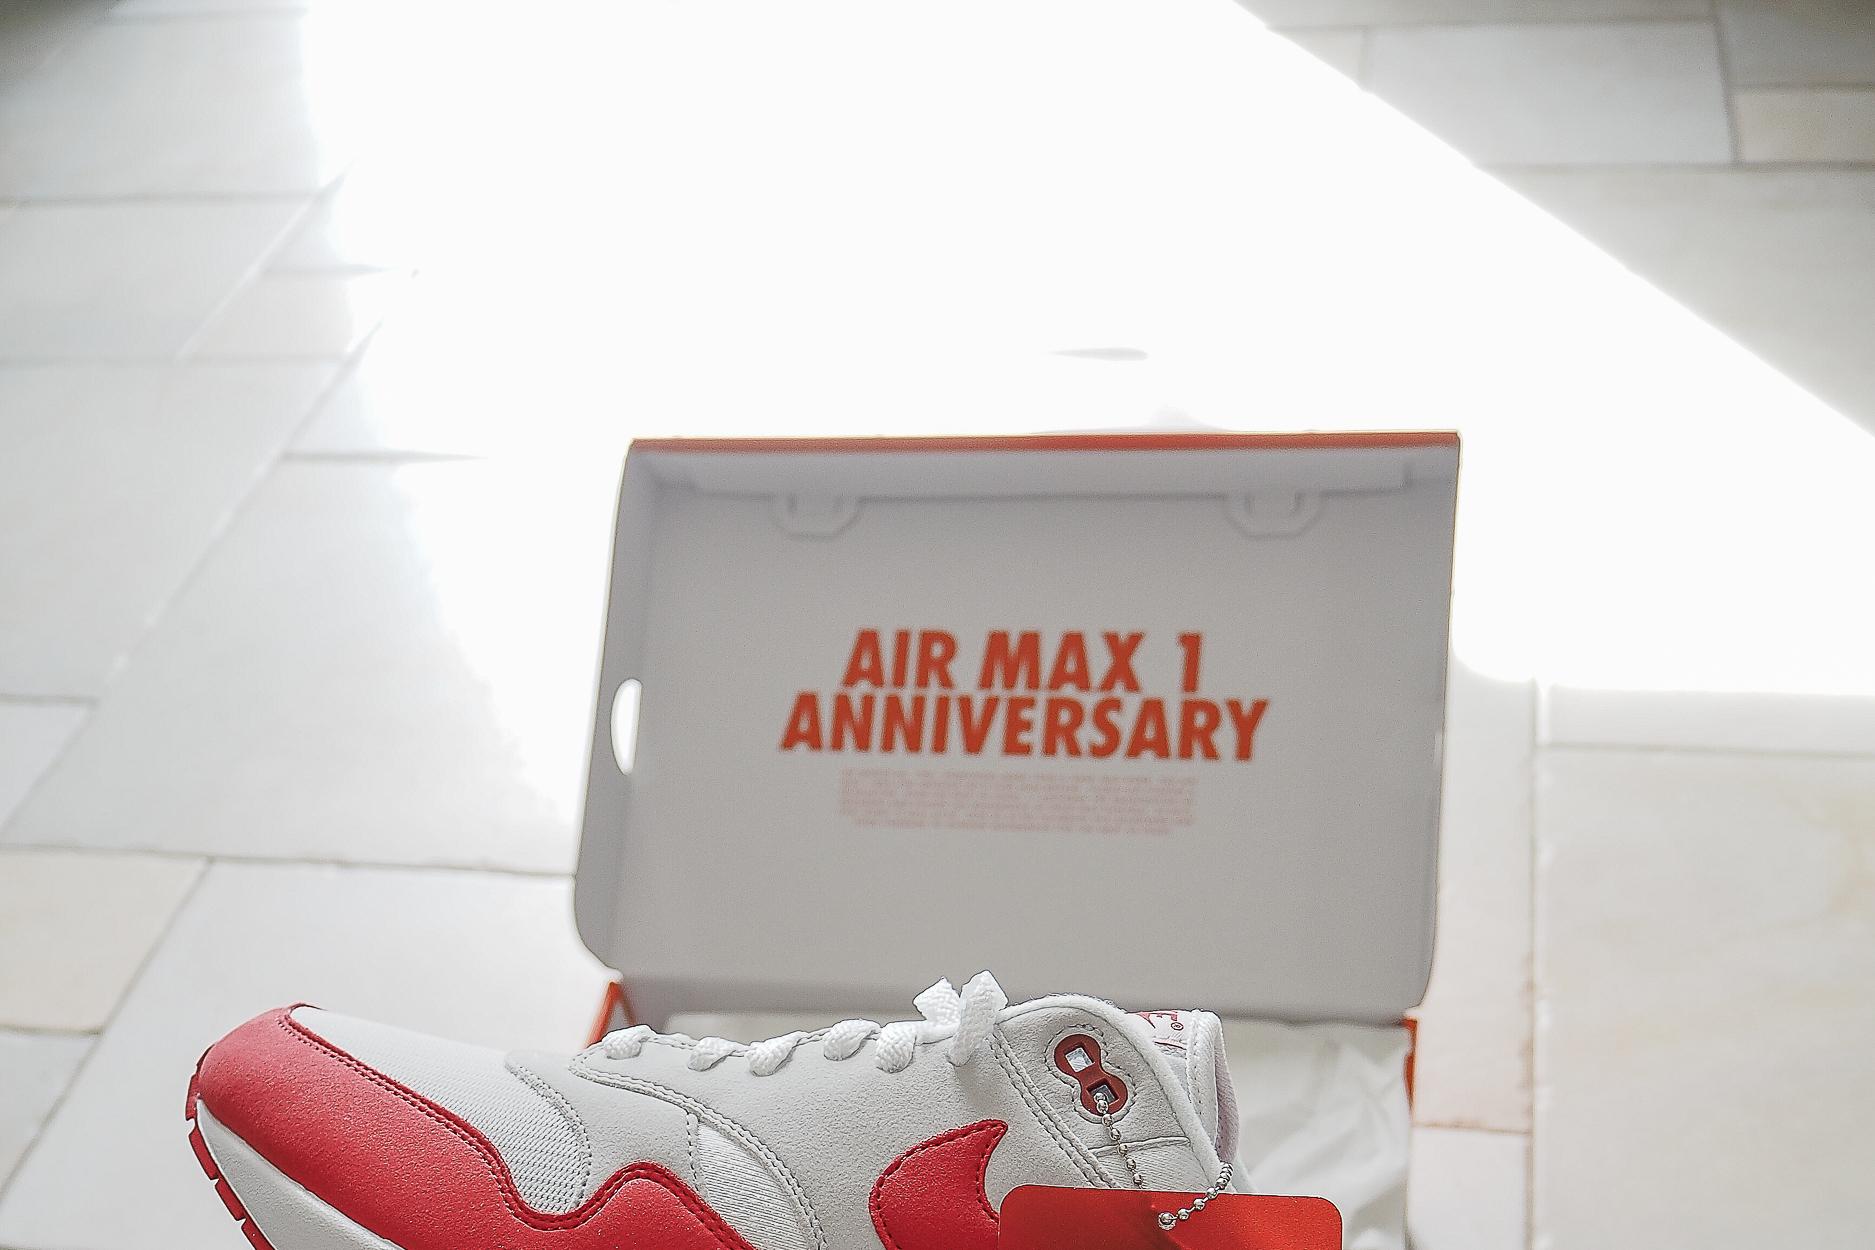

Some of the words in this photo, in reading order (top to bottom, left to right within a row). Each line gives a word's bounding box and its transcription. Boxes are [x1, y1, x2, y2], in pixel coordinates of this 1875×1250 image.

[841, 628, 959, 690] AIR
[977, 630, 1145, 692] MAX
[1176, 632, 1203, 694] 1
[780, 692, 1270, 762] ANNIVERSARY
